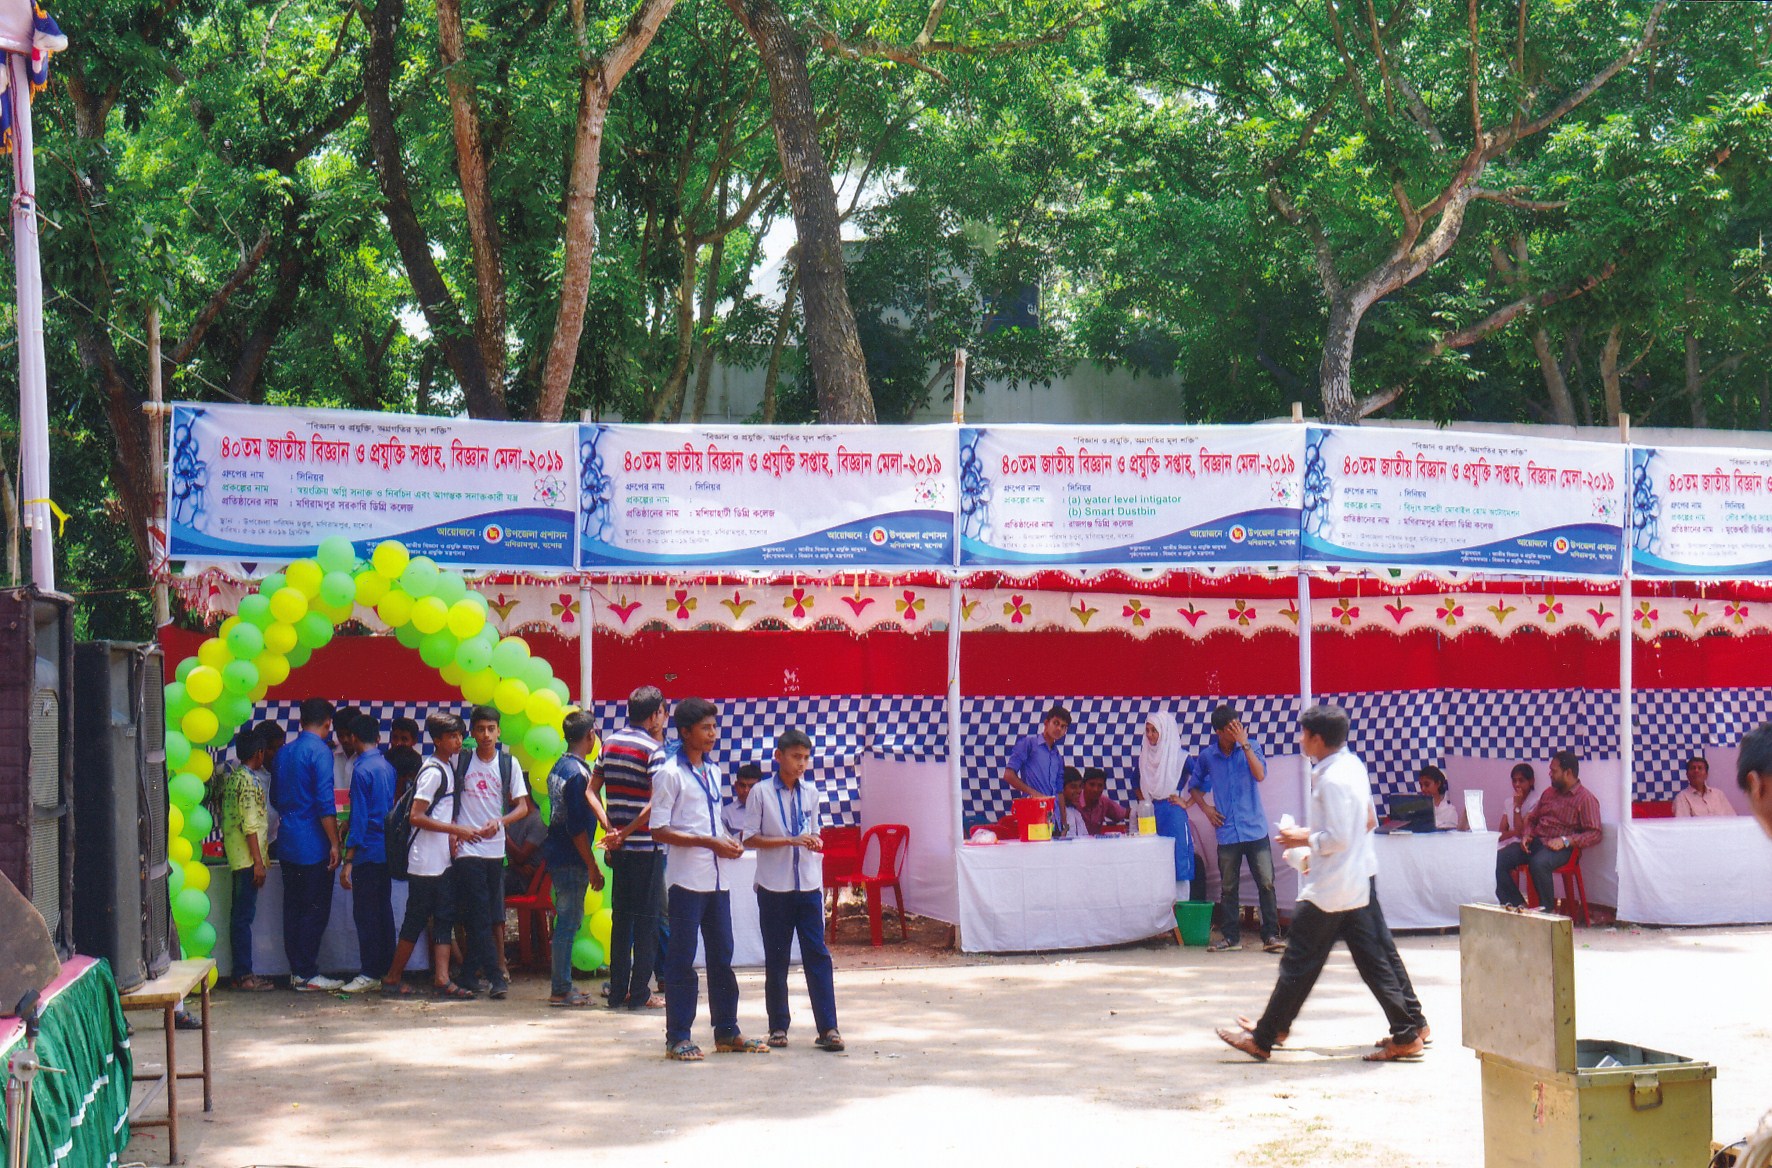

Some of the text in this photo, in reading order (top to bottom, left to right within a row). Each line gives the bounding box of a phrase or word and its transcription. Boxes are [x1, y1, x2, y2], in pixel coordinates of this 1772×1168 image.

[220, 431, 564, 474] ৪০তম জাতীয় বিজ্ঞান ও প্রযুক্তি সপ্তাহ, বিজ্ঞান মেলা-২০১৯
[623, 442, 941, 478] ৪০তম জাতীয় বিজ্ঞান ও প্রযুক্তি সপ্তাহ, বিজ্ঞান মেলা-২০১৯
[1002, 446, 1295, 480] ৪০তম জাতীয় বিজ্ঞান ও প্রযুক্তি সপ্তাহ, বিজ্ঞান মেলা-২০১৯
[222, 470, 247, 480] গ্রুপের
[296, 471, 324, 482] সিনিয়র
[1343, 450, 1615, 491] ৪০তম জাতীয় বিজ্ঞান ও প্রযুক্তি সপ্তাহ, বিজ্ঞান মেলা-২০১৯
[1669, 474, 1698, 493] ৪০তম
[1701, 467, 1730, 493] জাতীয়
[1734, 468, 1762, 493] বিজ্ঞান
[625, 483, 649, 491] গ্রুপের
[695, 481, 720, 491] সিনিয়র
[1004, 484, 1025, 492] গ্রুপের
[1067, 482, 1091, 492] সিনিয়র
[1404, 488, 1426, 498] সিনিয়র
[1068, 495, 1181, 505] (a) water level intigator
[1068, 507, 1156, 517] (b) Smart Dustbin
[436, 527, 568, 540] আয়োজনে উপজেলা প্রশাসন
[827, 531, 947, 540] আয়োজনে উপজেলা প্রশাসন
[1190, 528, 1300, 537] আয়োজনে উপজেলা প্রশাসন
[1517, 539, 1547, 547] আয়োজনে
[1571, 540, 1595, 550] উপজেলা
